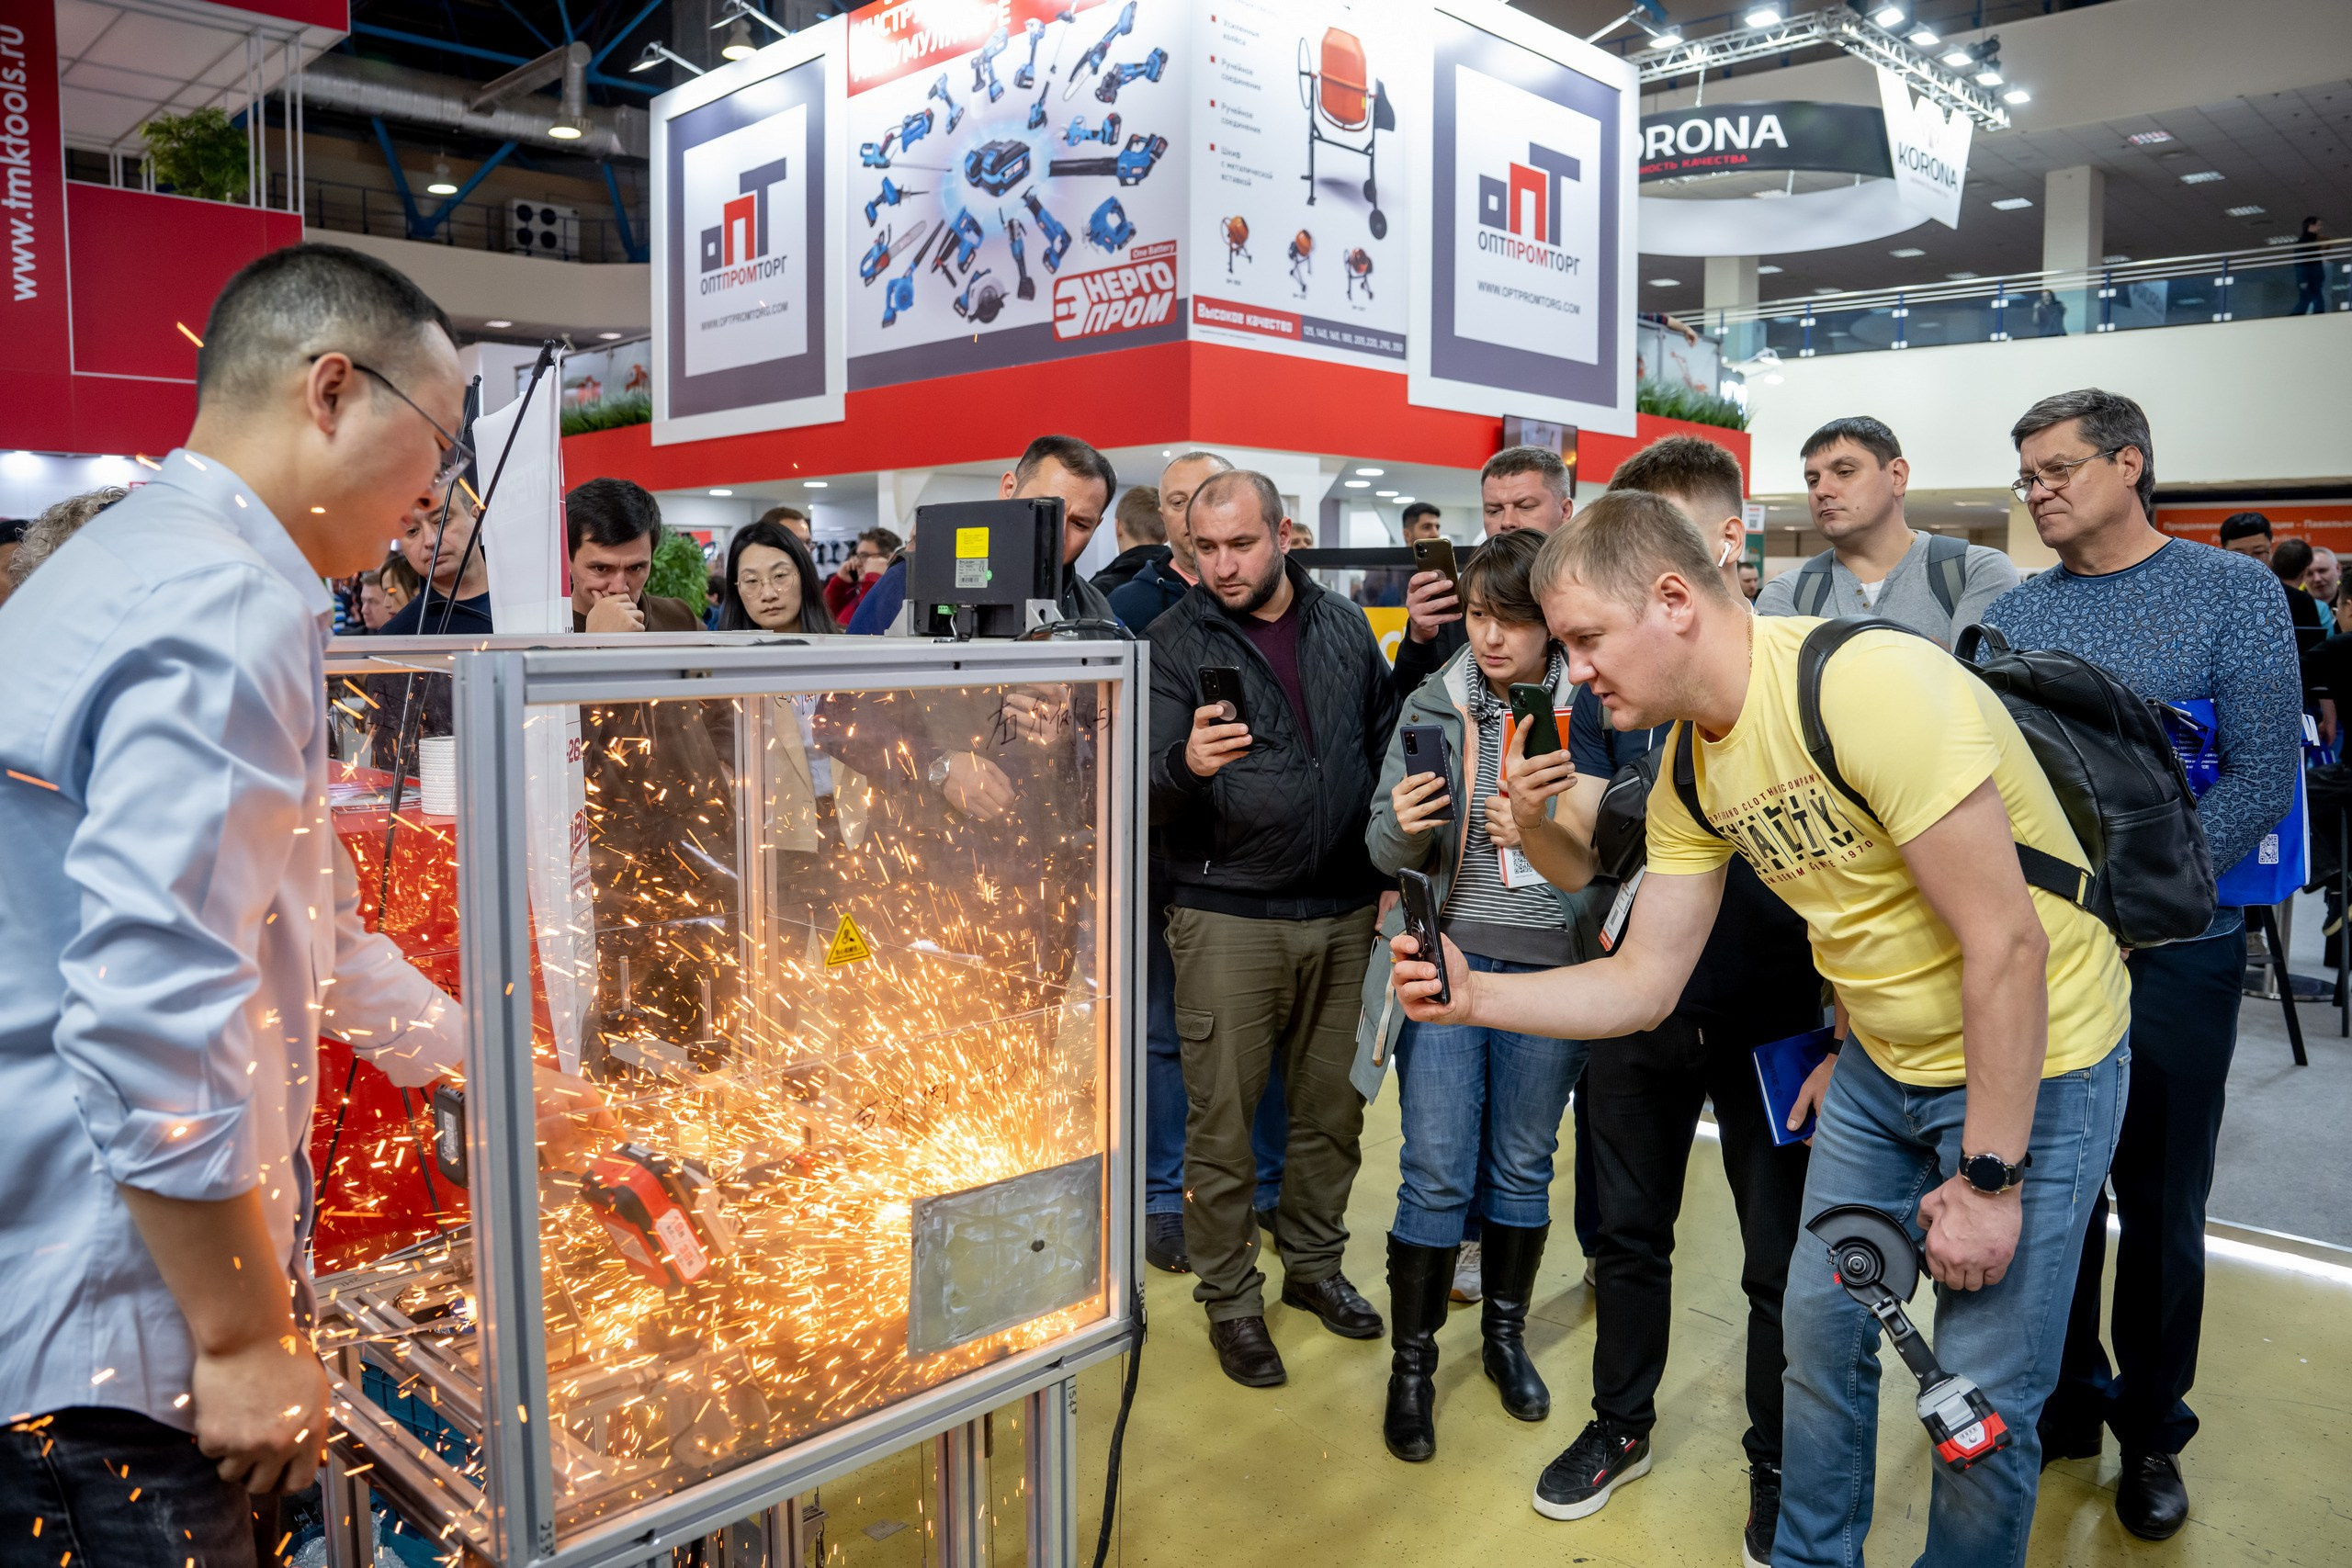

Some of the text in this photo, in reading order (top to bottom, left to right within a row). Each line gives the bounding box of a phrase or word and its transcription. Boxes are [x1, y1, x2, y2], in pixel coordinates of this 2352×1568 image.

[1639, 114, 1789, 160] RONA
[0, 24, 38, 301] www.tmktools.ru
[1681, 153, 1748, 168] КАЧЕСТВА
[1898, 141, 1958, 192] KORONA
[1148, 243, 1175, 255] Battery
[1478, 231, 1580, 276] ОПТПРОМТОРГ
[701, 255, 787, 296] ОПТПРОМТОРГ
[1083, 290, 1174, 334] ПРОМ
[1197, 302, 1294, 333] Высокое качество
[1477, 280, 1581, 315] WWW.OPTPROMTORG.COM
[1840, 840, 1873, 863] 1970
